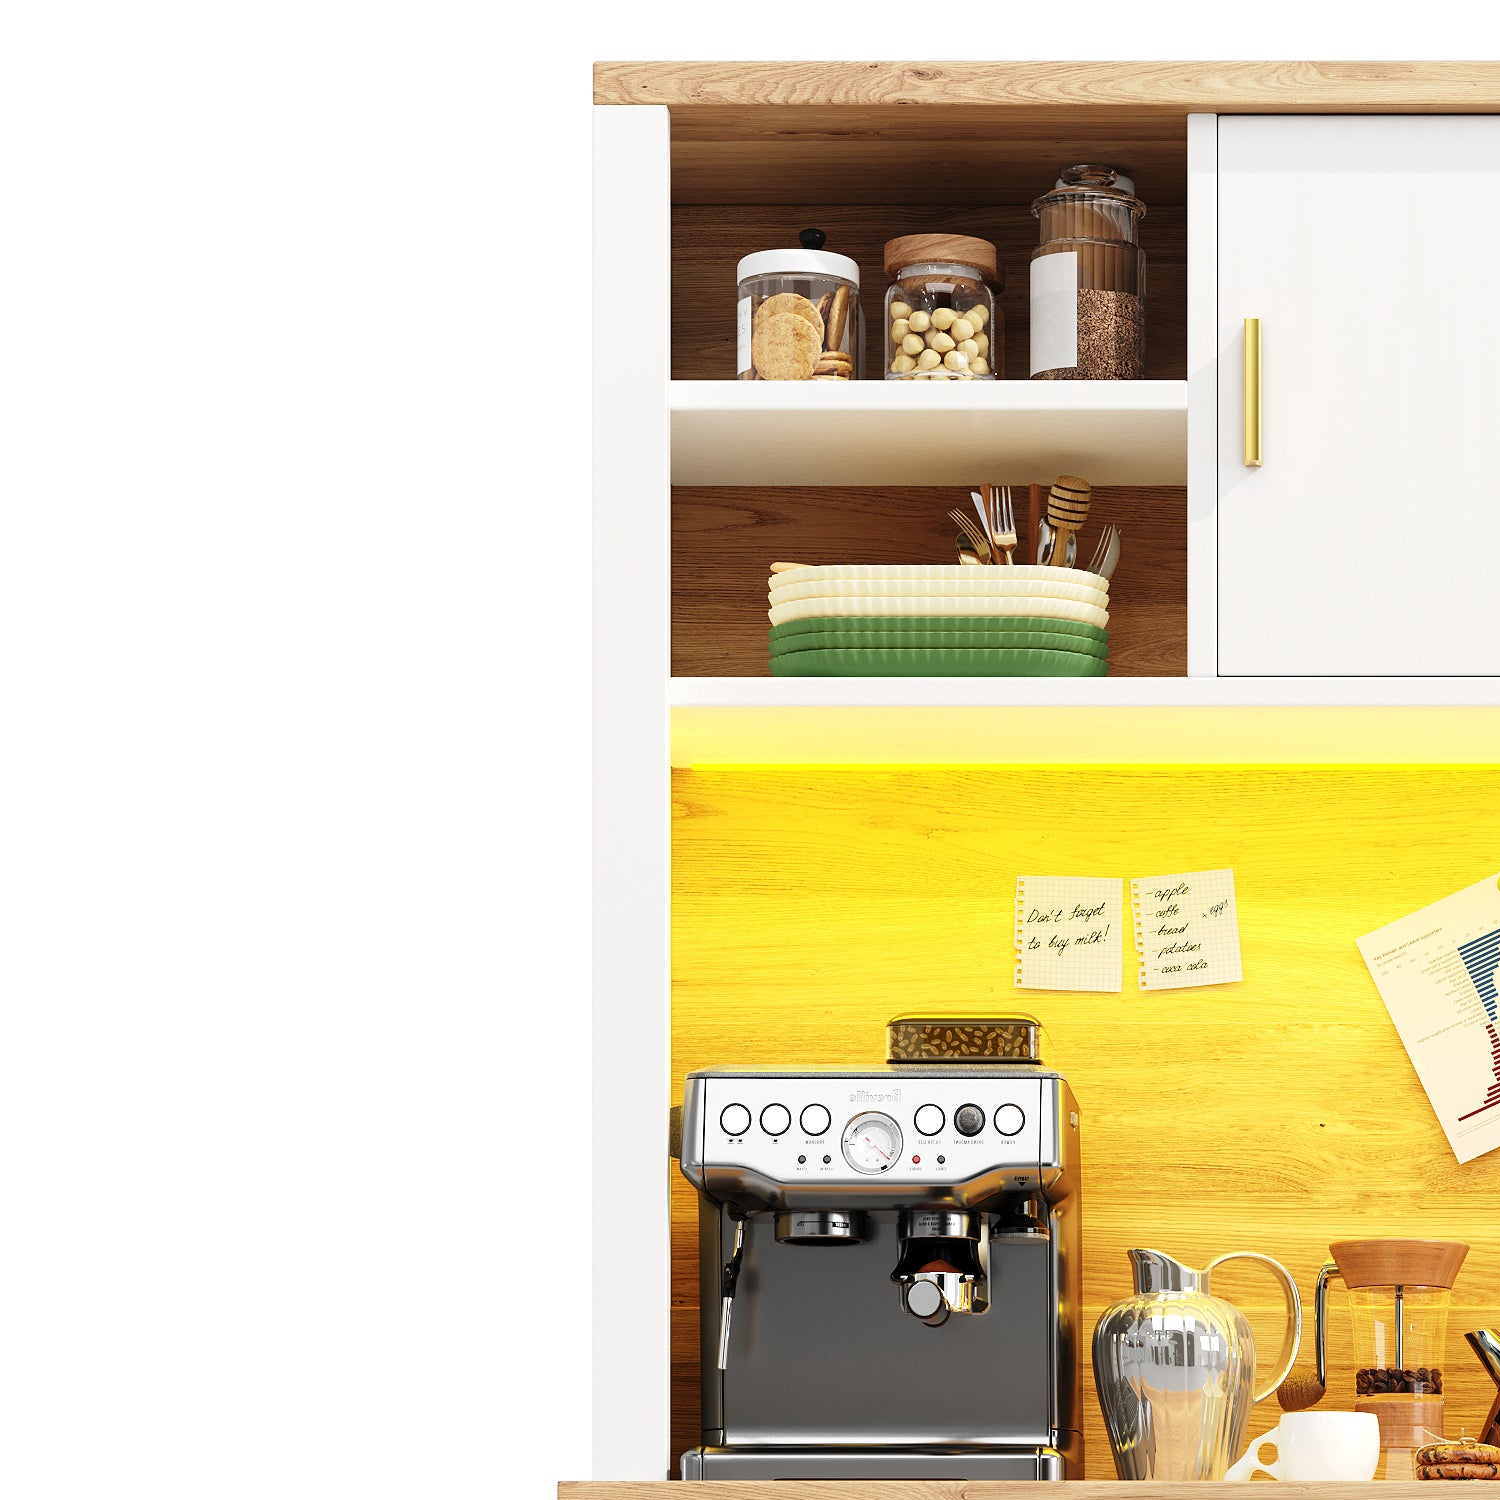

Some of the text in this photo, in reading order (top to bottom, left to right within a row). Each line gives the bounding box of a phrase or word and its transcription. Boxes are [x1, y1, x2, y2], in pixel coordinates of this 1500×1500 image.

[1027, 902, 1106, 924] Don't forget
[1028, 924, 1111, 956] to buy milk!
[1158, 923, 1189, 937] bread
[1158, 941, 1202, 959] potatoes
